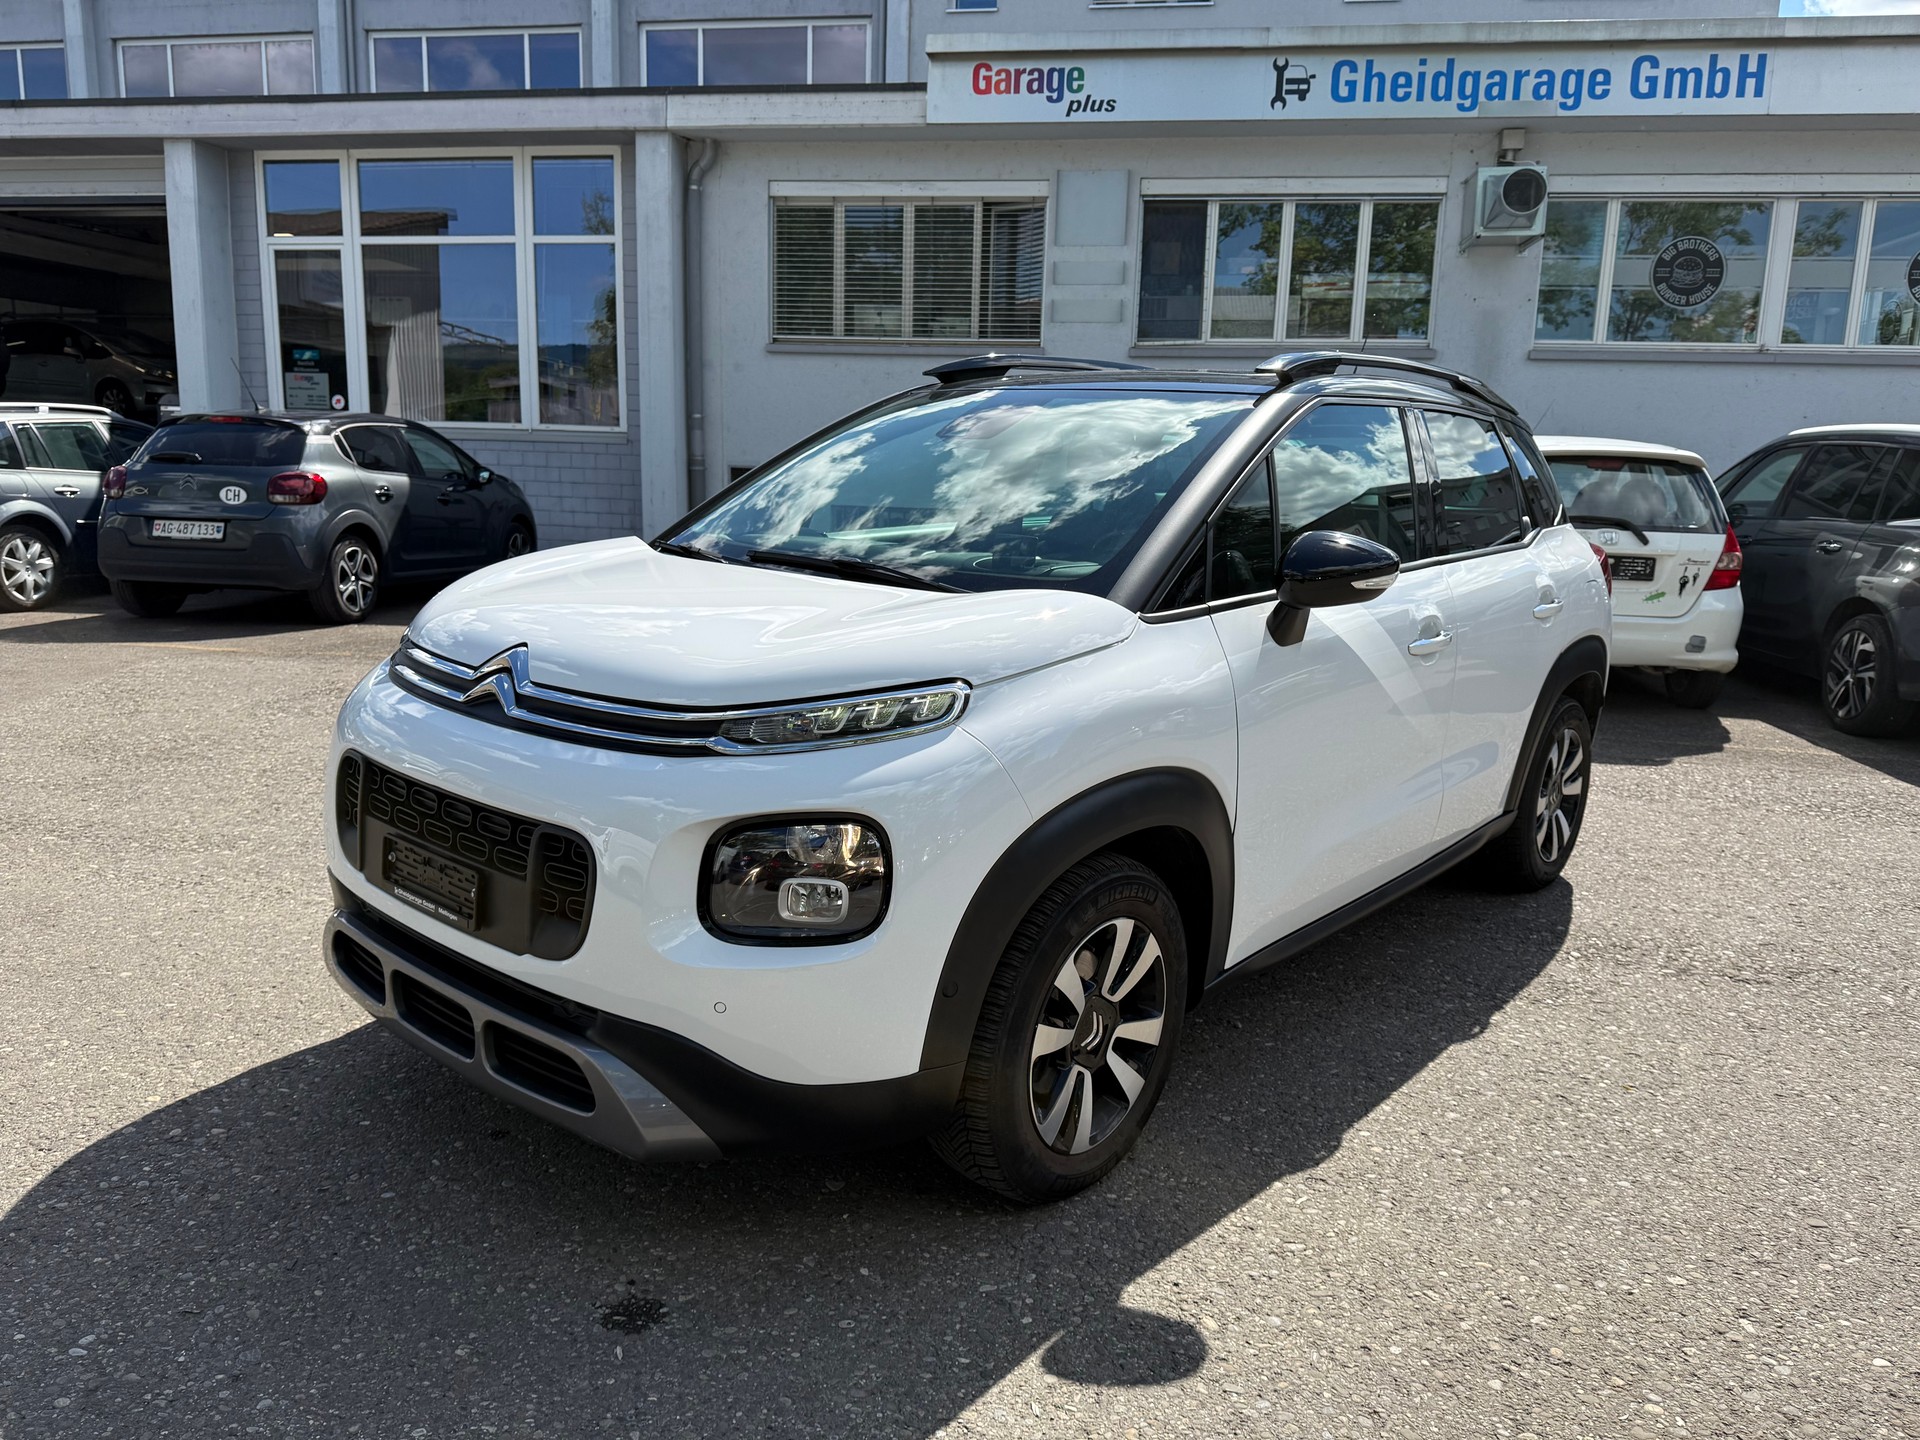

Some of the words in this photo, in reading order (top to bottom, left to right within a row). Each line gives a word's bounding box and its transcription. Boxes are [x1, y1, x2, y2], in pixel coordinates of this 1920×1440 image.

[972, 62, 1085, 104] Garage
[1330, 57, 1612, 112] Gheidgarage
[1629, 53, 1768, 100] GmbH
[1065, 94, 1117, 117] plus
[1661, 246, 1677, 261] BIG
[1677, 239, 1719, 261] BROTHERS
[1656, 282, 1687, 305] BURGER
[1688, 282, 1716, 305] HOUSE
[225, 488, 241, 502] CH
[1097, 884, 1158, 907] MICHELIN
